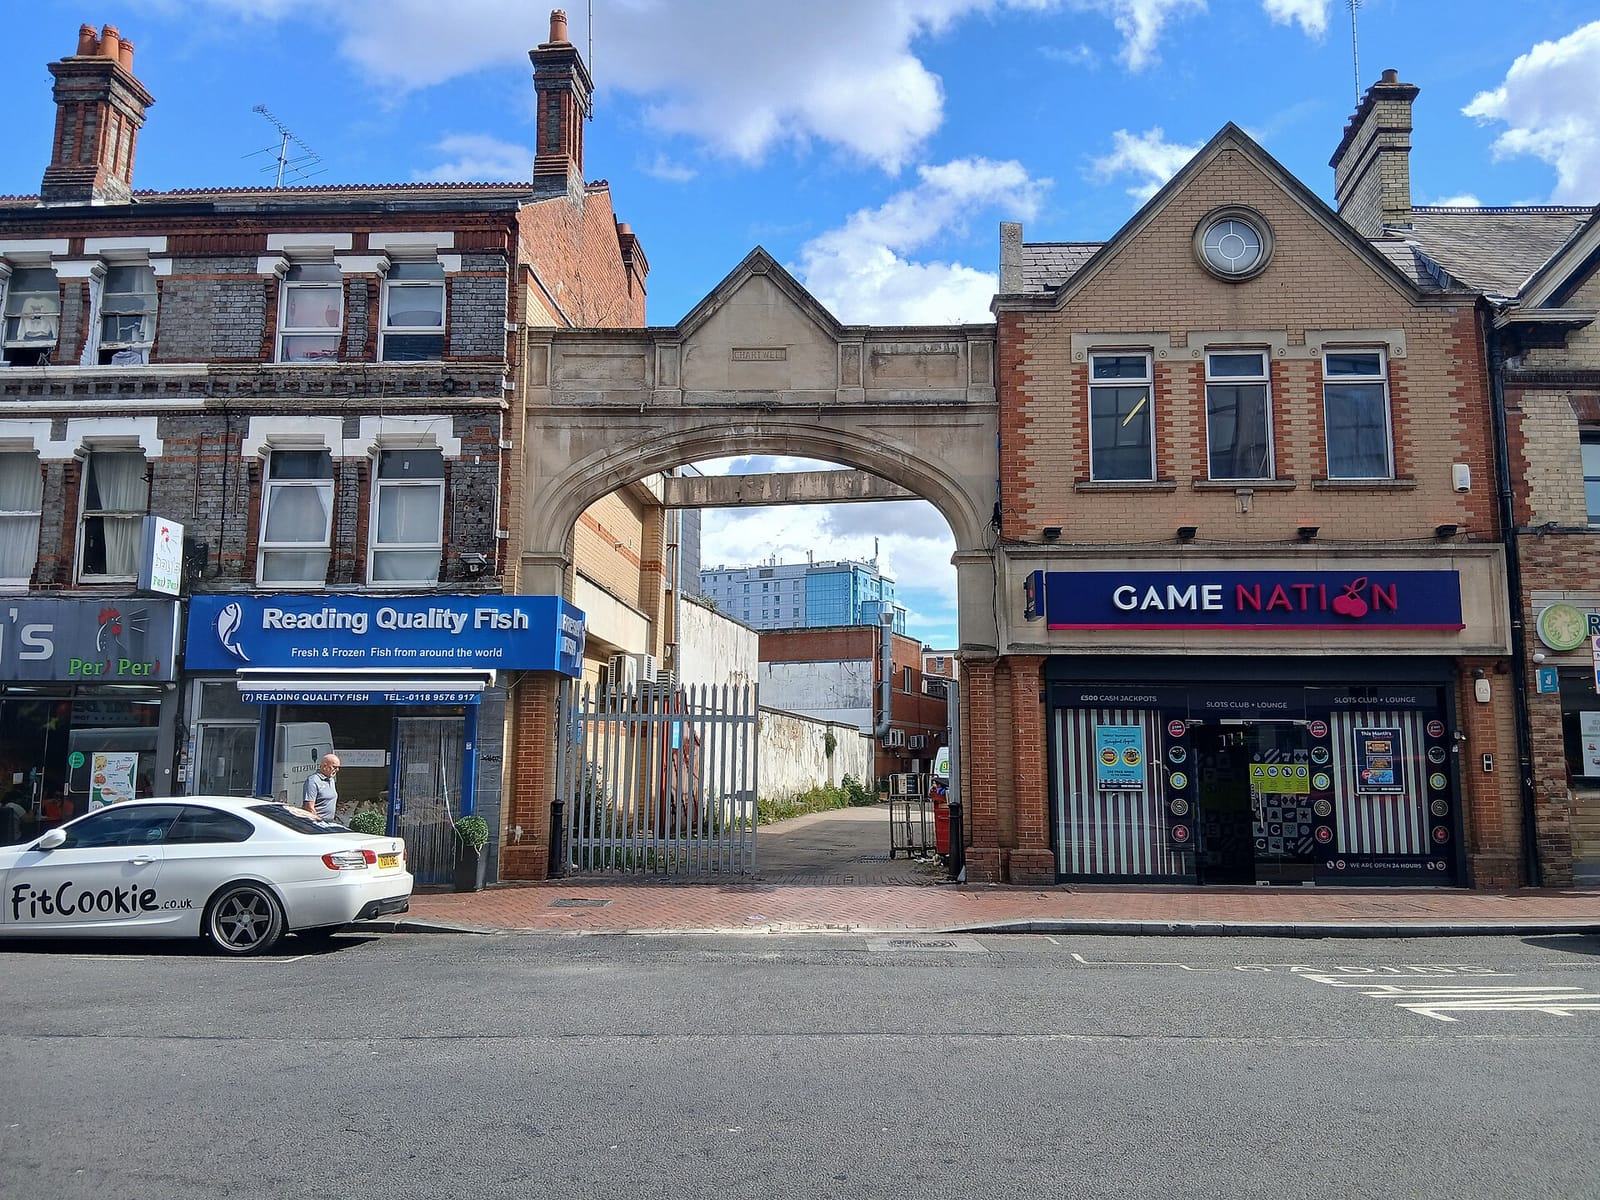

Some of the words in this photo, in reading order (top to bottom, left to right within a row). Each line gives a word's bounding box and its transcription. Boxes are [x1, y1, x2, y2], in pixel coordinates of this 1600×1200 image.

[1113, 585, 1224, 610] GAME
[262, 608, 368, 634] Reading
[376, 607, 468, 634] Quality
[474, 608, 529, 630] Fish
[292, 647, 319, 657] Fresh
[322, 647, 329, 657] &
[332, 647, 366, 657] Frozen
[371, 647, 392, 657] Fish
[394, 647, 417, 657] from
[419, 647, 454, 657] around
[457, 647, 472, 657] the
[475, 647, 503, 657] world
[241, 693, 254, 702] (7)
[256, 693, 300, 701] READING
[302, 693, 345, 701] QUALITY
[346, 693, 369, 701] FISH
[433, 693, 456, 701] 9576
[458, 693, 475, 701] 917
[1333, 696, 1357, 704] SLOTS
[1358, 696, 1378, 704] CLUB
[1180, 964, 1497, 974] LOADING
